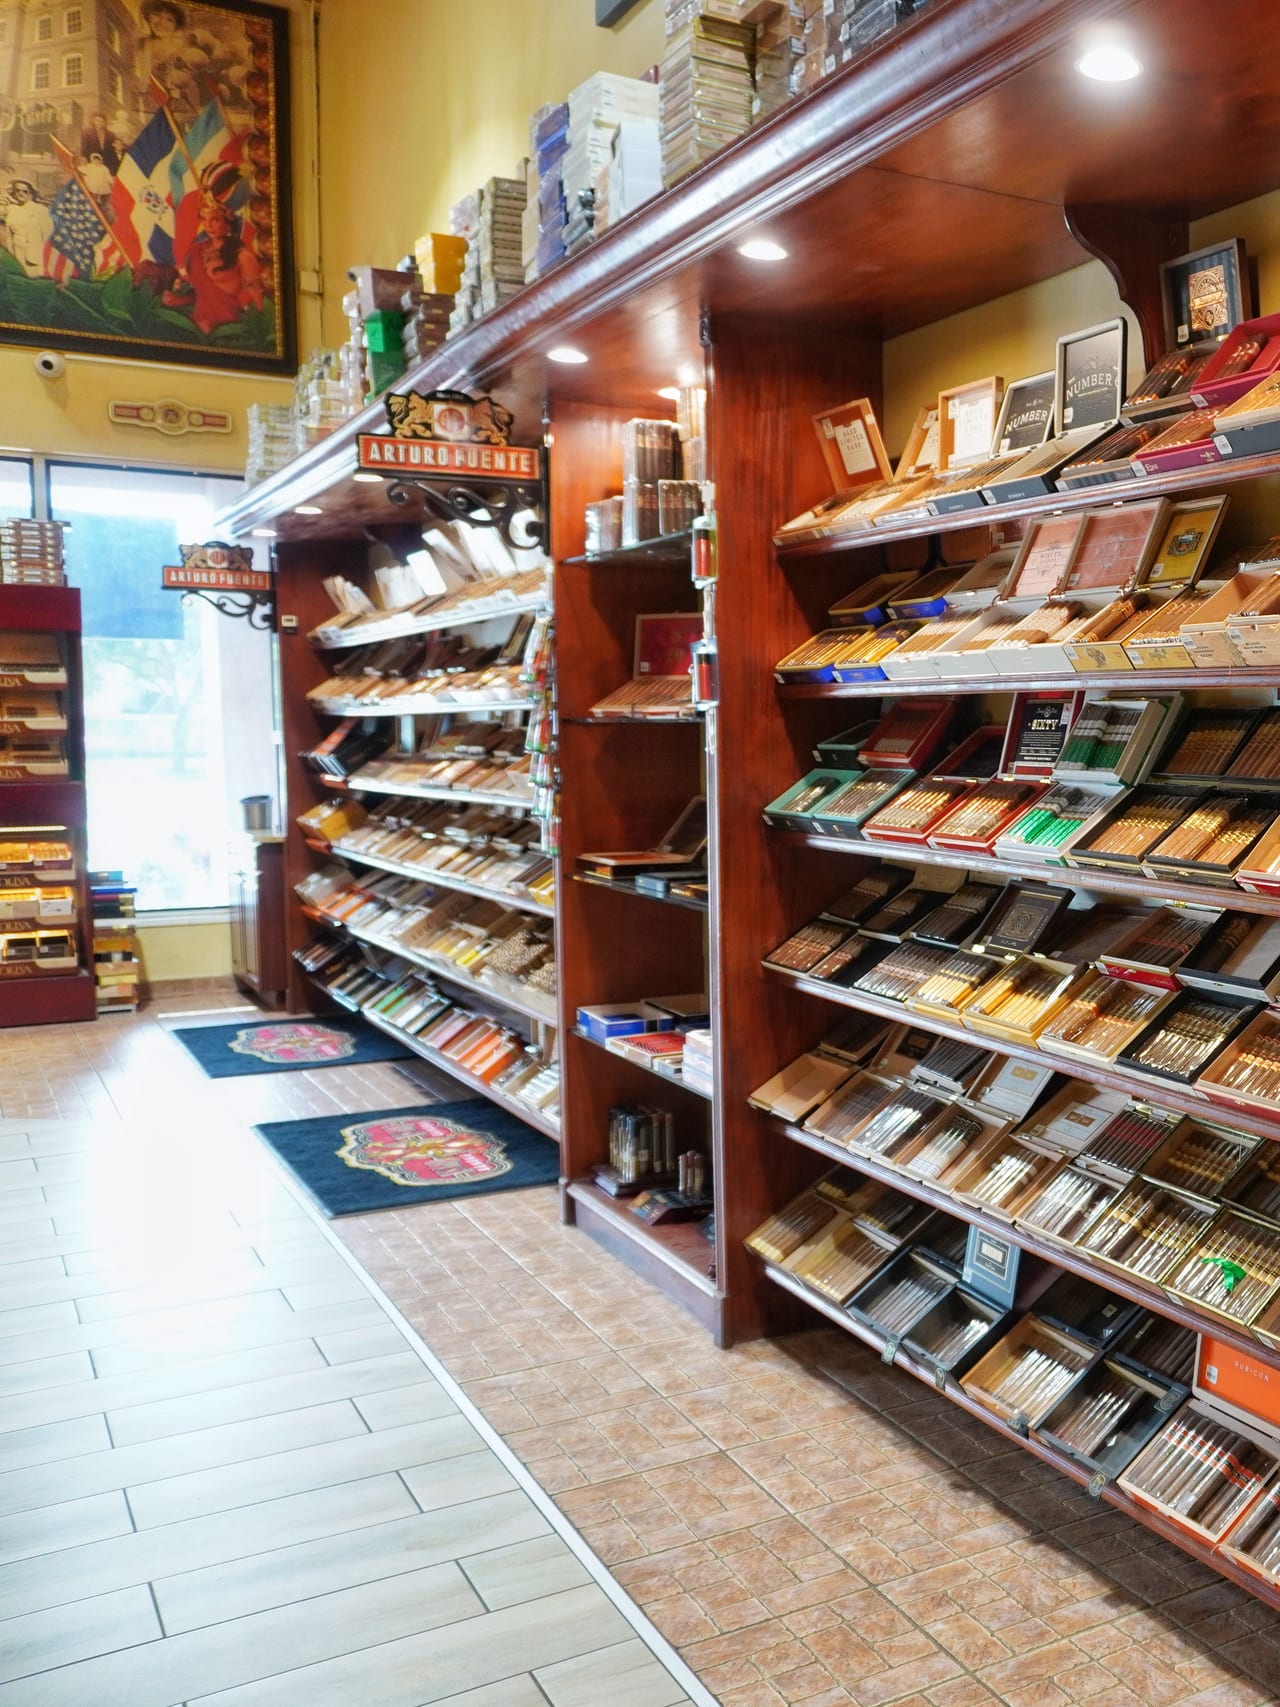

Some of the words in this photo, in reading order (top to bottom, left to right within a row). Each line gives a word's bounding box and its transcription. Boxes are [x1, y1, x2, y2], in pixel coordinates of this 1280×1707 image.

[1066, 373, 1113, 401] NUMBER
[1005, 409, 1048, 435] NUMBER
[369, 442, 449, 467] ARTURO
[455, 448, 531, 473] FUENTE
[170, 571, 216, 584] ARTURO
[219, 572, 264, 587] FUENTE
[1031, 719, 1058, 730] SIXTY
[1234, 1360, 1270, 1383] RUBICON
